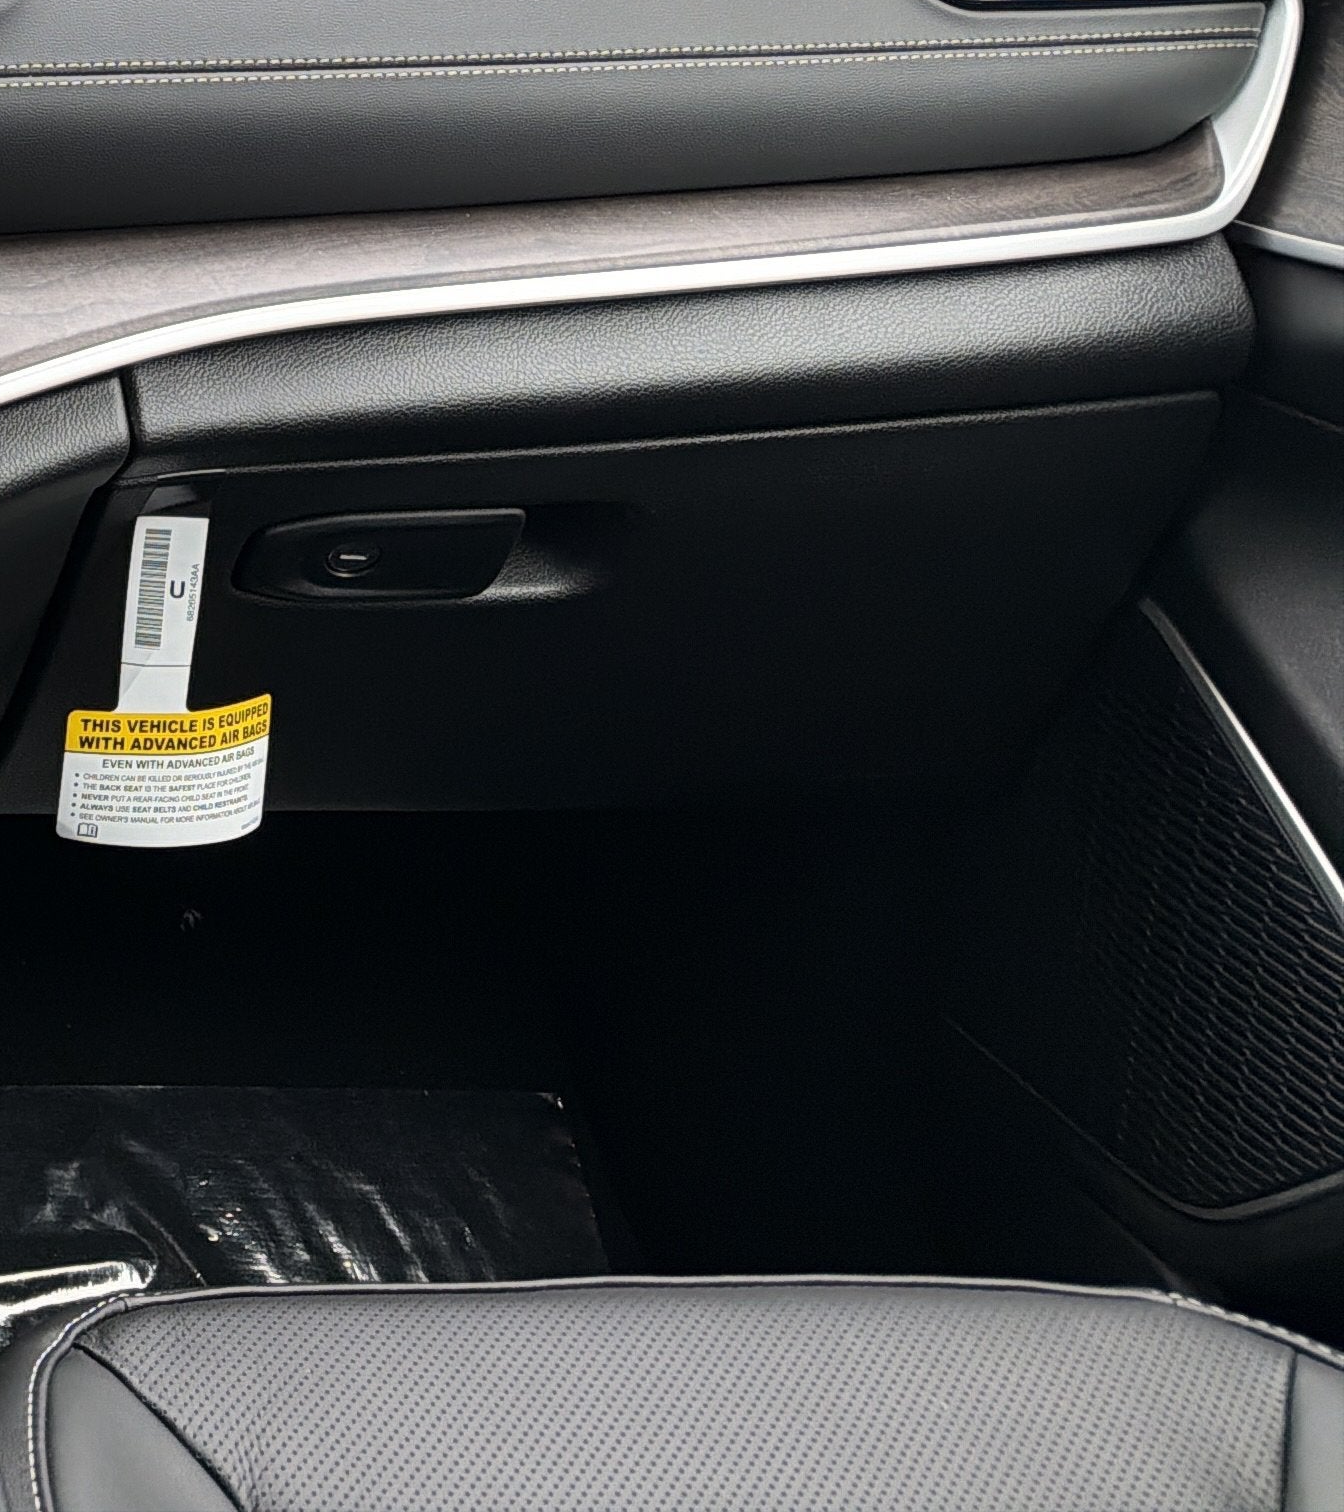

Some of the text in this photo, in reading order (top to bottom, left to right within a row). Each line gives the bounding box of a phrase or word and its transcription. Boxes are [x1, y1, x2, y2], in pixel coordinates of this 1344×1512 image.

[170, 580, 185, 599] U
[80, 702, 268, 733] THIS VEHICLE IS EQUIPPED
[78, 719, 267, 750] WITH ADVANCED AIR BAGS
[102, 746, 255, 769] EVEN WITH ADVANCED AIR BAGS
[83, 773, 120, 782] CHILDREN
[83, 782, 97, 790] THE
[99, 783, 121, 791] BACK
[169, 784, 196, 792] SAFEST
[81, 793, 109, 801] NEVER
[202, 792, 216, 800] SEAT
[80, 803, 113, 811] ALWAYS
[178, 805, 191, 813] AND
[193, 803, 213, 811] CHILD
[95, 814, 128, 823] OWNER'S
[176, 815, 194, 823] MORE
